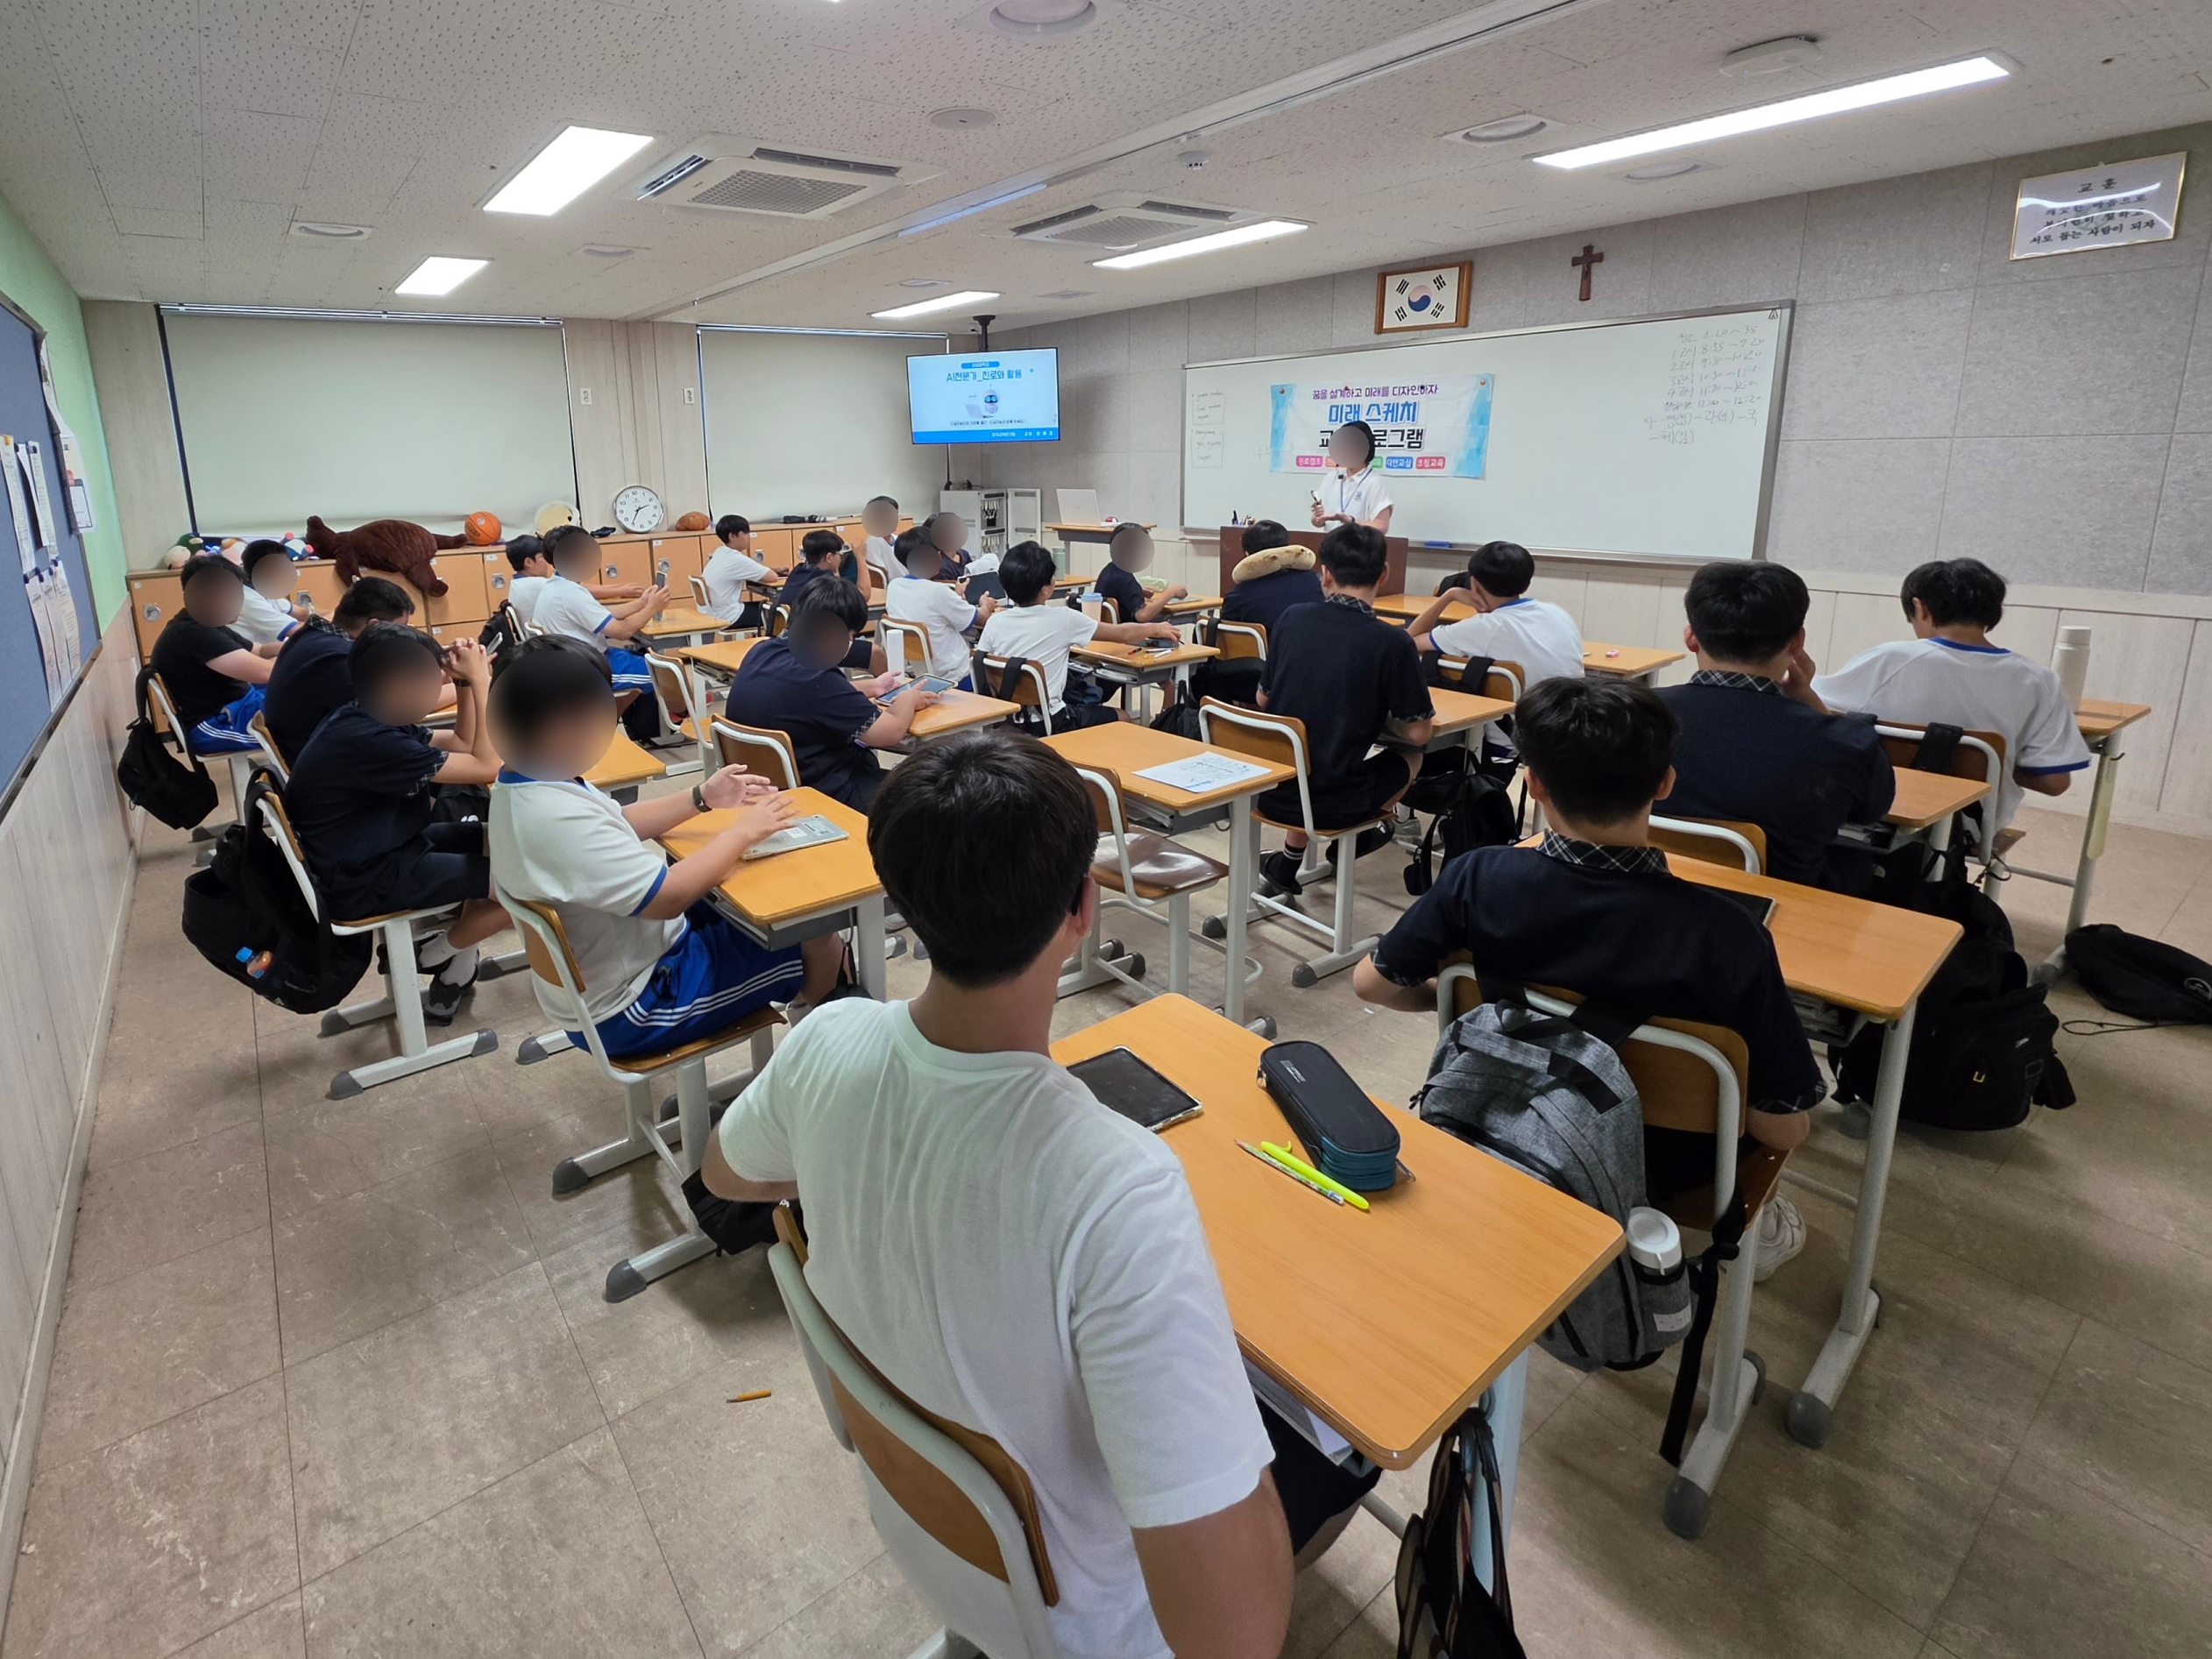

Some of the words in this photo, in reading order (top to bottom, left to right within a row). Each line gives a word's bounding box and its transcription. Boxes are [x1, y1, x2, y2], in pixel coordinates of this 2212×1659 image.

[2078, 178, 2117, 193] 교훈
[1313, 388, 1328, 400] 꿈을
[1329, 386, 1363, 400] 설계하고
[1365, 386, 1390, 398] 미래를
[1392, 384, 1439, 396] 디자인하자
[1329, 403, 1361, 423] 미래
[1365, 401, 1418, 423] 스케치
